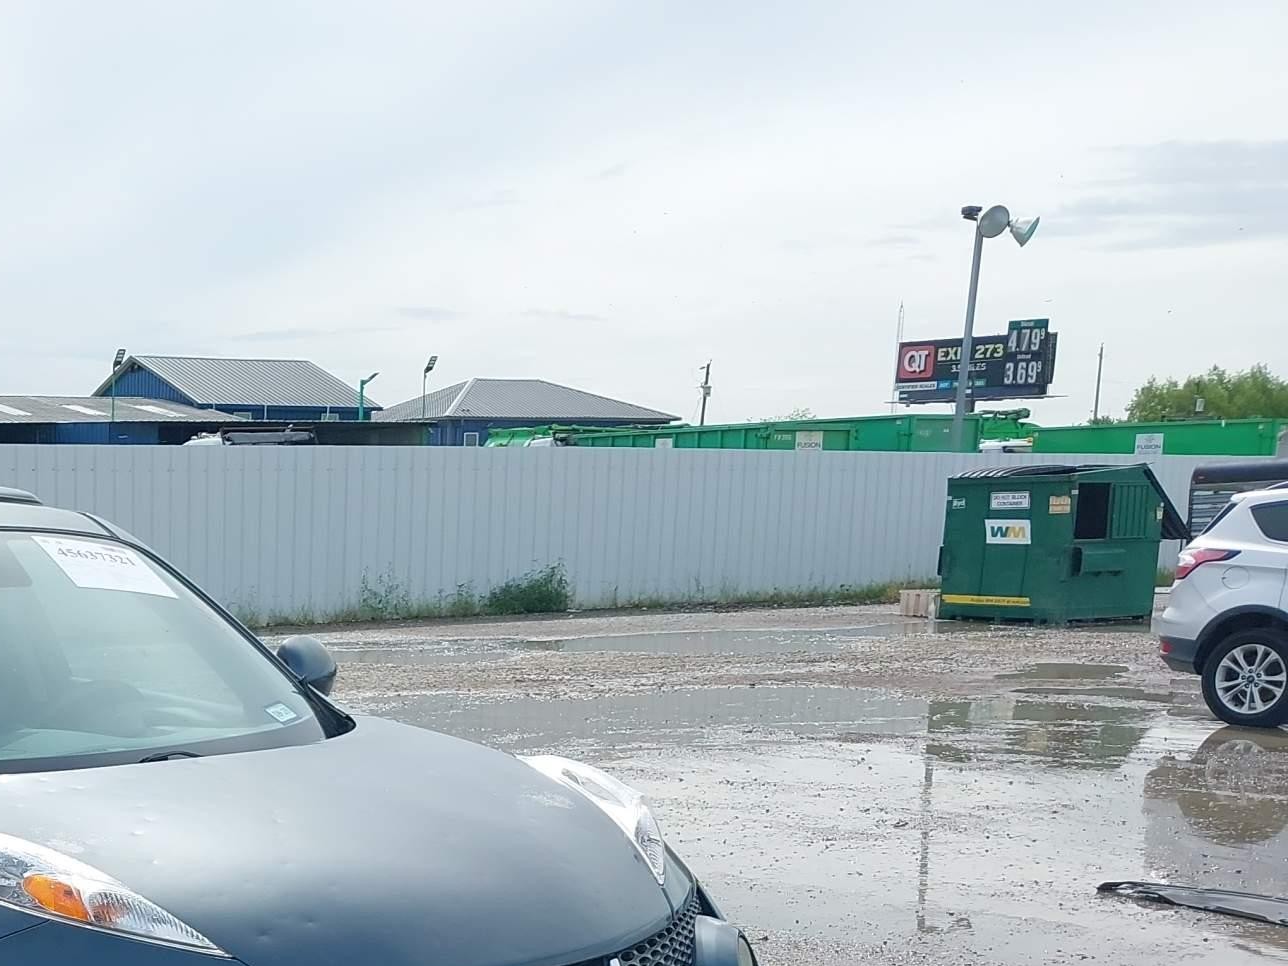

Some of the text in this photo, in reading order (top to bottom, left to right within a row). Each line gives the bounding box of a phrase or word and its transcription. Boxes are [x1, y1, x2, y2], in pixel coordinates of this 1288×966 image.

[903, 350, 930, 373] QT
[937, 343, 1004, 361] EXI 273
[990, 526, 1026, 538] WM
[56, 547, 137, 567] 45637321
